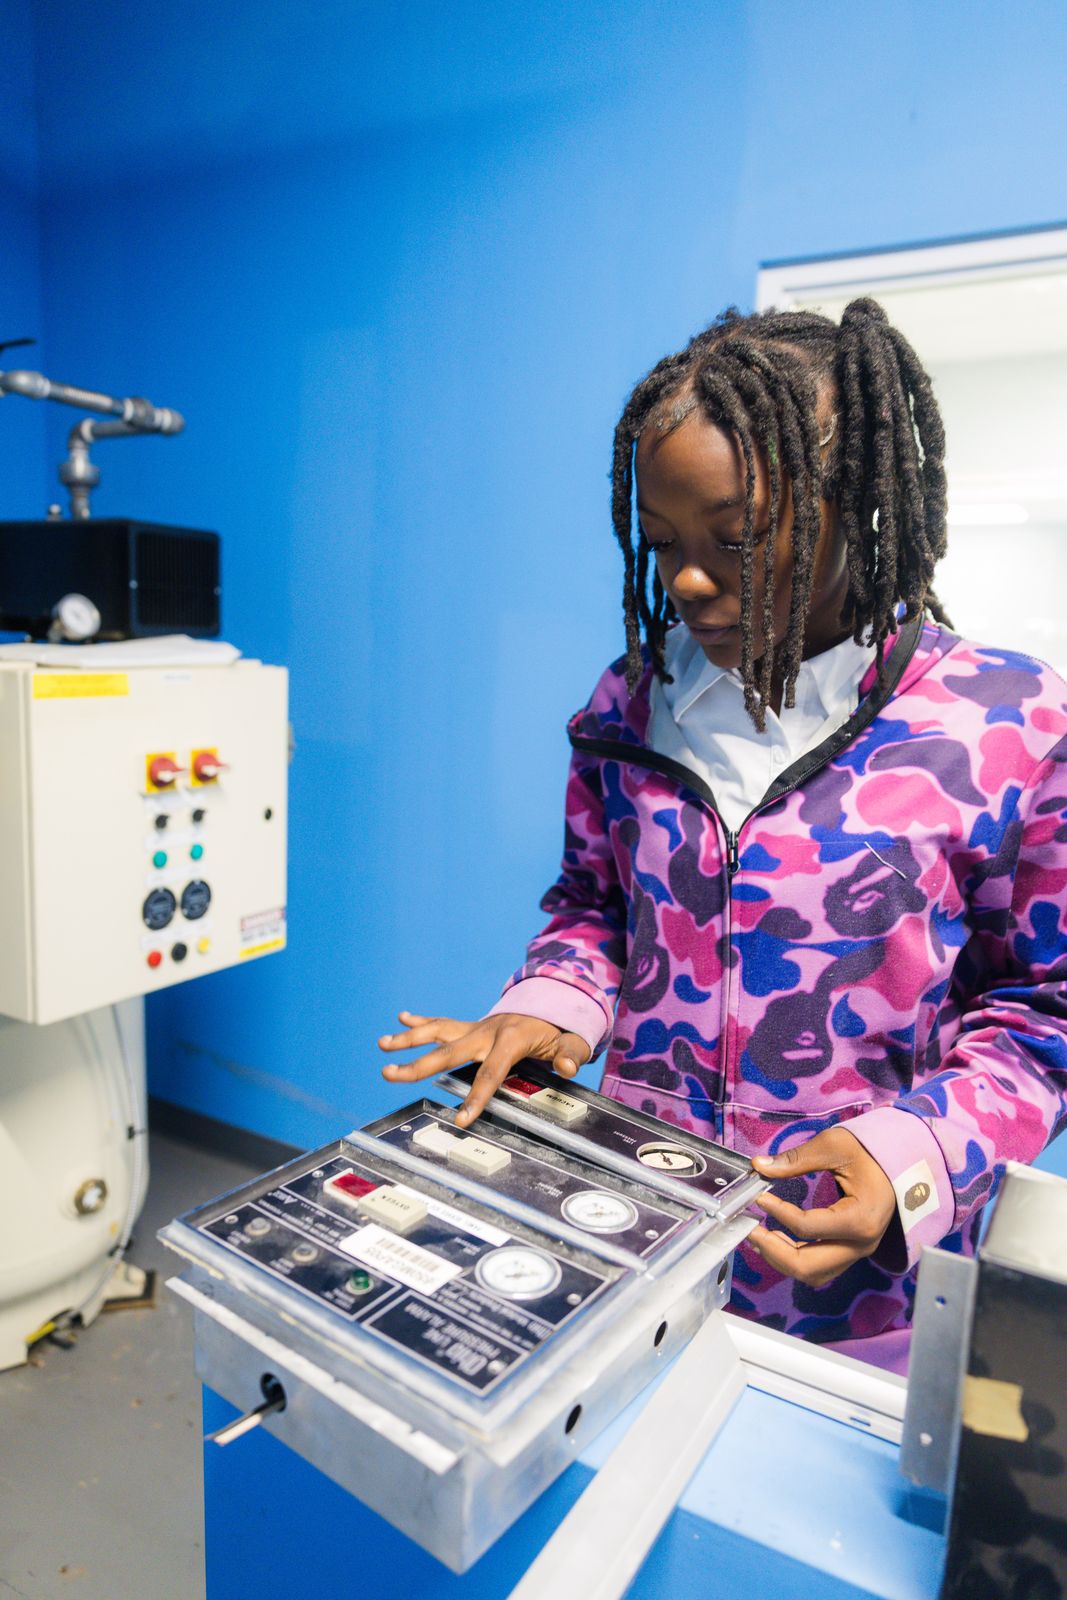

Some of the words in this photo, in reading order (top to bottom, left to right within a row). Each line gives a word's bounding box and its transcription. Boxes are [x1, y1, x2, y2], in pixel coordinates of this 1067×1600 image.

[544, 1093, 575, 1108] VACUUM
[472, 1147, 488, 1155] AIR
[377, 1193, 412, 1211] OXYGEN
[401, 1301, 449, 1329] ALARM
[419, 1326, 454, 1348] LINE
[439, 1321, 504, 1359] PRESSURE
[436, 1341, 492, 1377] Ohio
